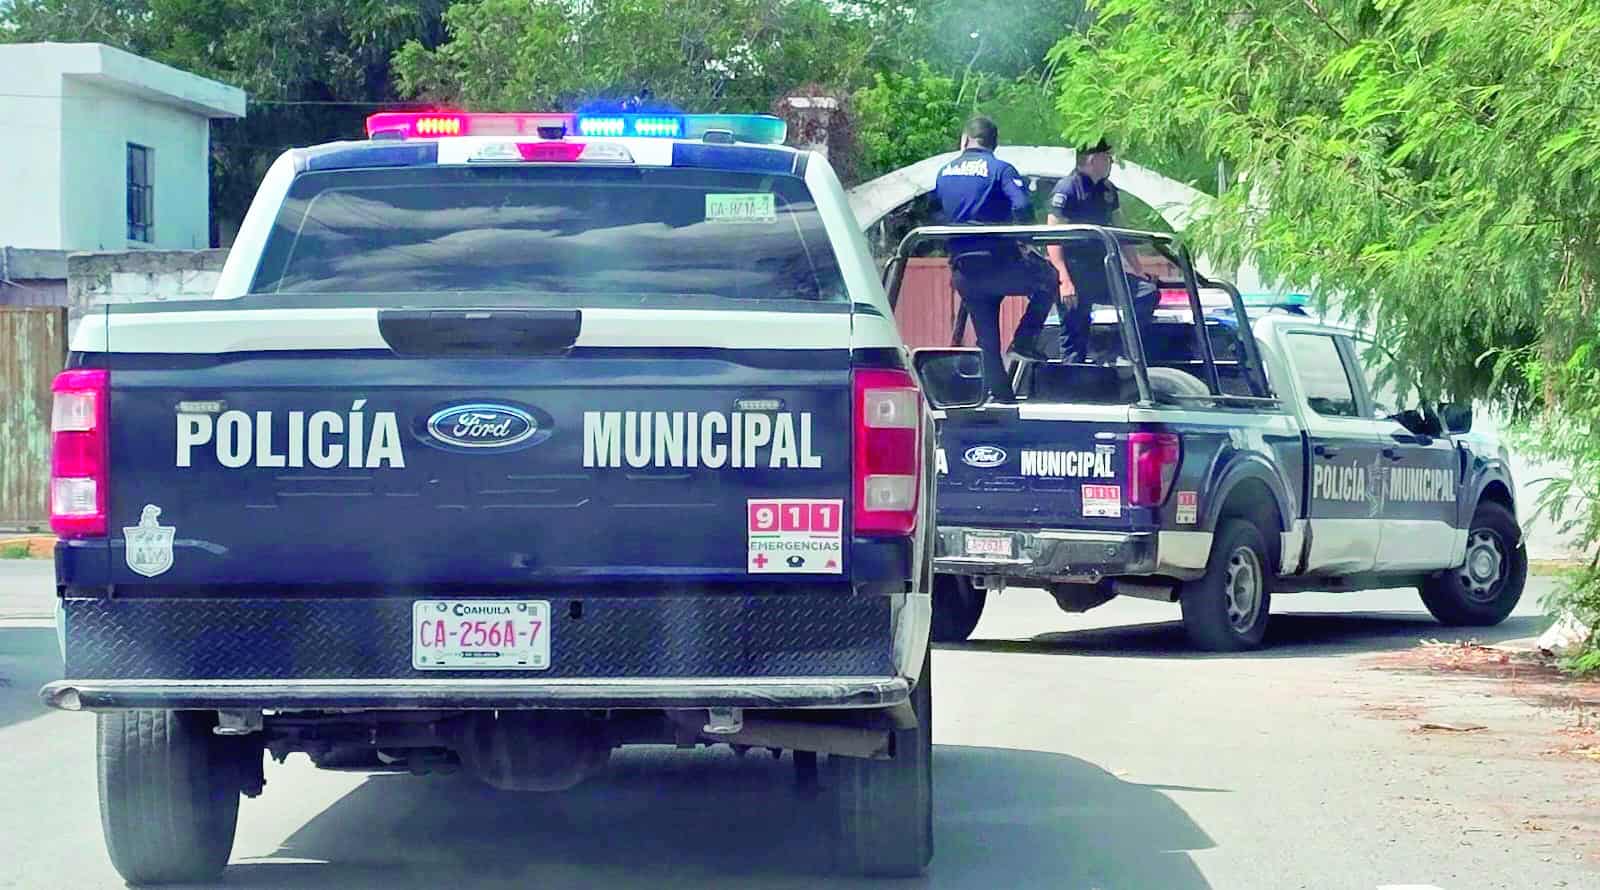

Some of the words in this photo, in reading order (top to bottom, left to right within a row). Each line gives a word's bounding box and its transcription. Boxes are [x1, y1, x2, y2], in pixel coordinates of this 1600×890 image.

[176, 399, 406, 469] POLICÍA
[453, 412, 512, 437] Ford
[583, 410, 822, 469] MUNICIPAL
[1020, 450, 1115, 478] MUNICIPAL
[1313, 460, 1366, 502] POLICÍA
[1390, 466, 1457, 502] MUNICIPAL
[756, 506, 831, 529] 911
[750, 541, 840, 551] EMERGENCIAS
[453, 603, 511, 616] COAHUILA
[420, 619, 543, 648] CA-256A-7
